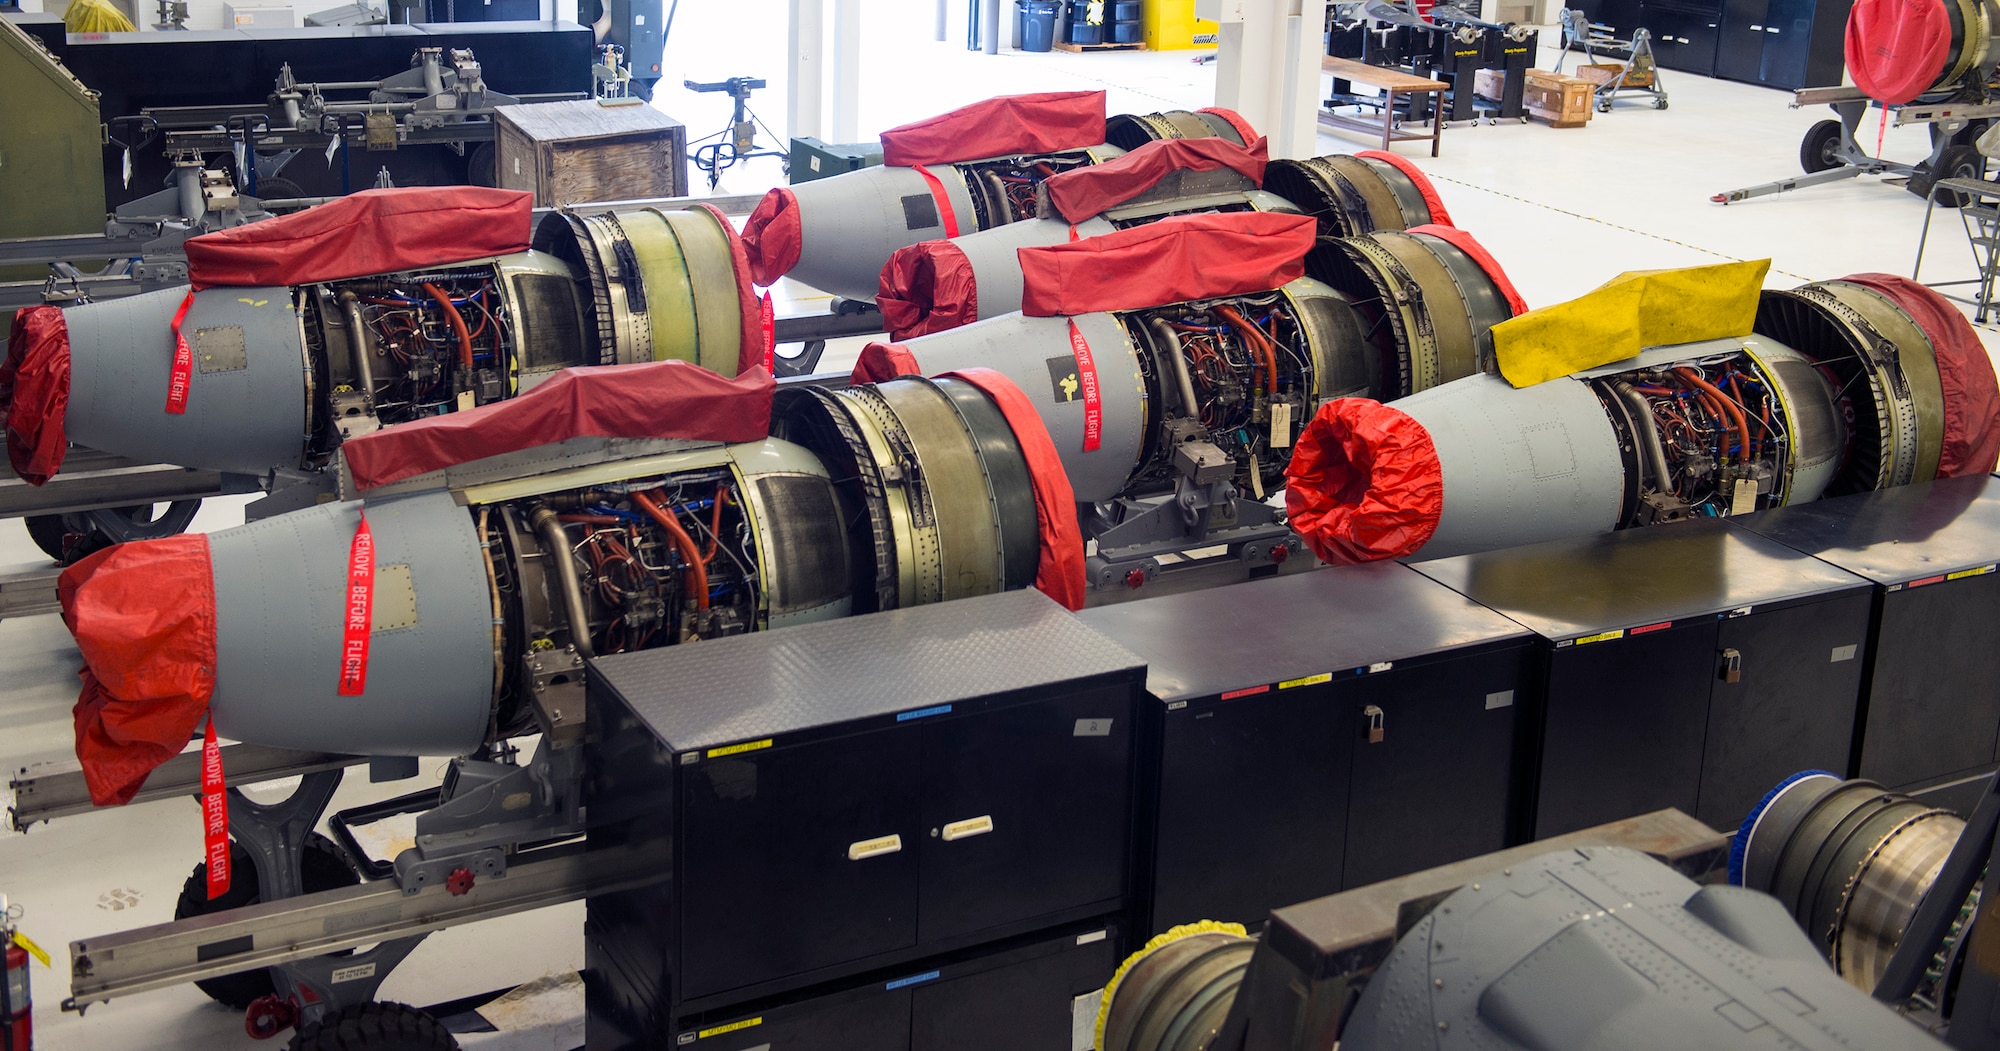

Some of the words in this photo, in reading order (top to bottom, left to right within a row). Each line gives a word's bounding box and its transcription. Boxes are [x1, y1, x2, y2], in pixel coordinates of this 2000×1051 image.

[762, 300, 771, 326] REMOVE
[1072, 334, 1090, 366] REMOVE
[170, 371, 186, 402] FLIGHT
[1083, 371, 1097, 404] BEFORE
[1088, 410, 1098, 440] FLIGHT
[354, 534, 370, 576] REMOVE
[350, 586, 367, 630] BEFORE
[345, 640, 363, 681] FLIGHT
[206, 742, 222, 786] REMOVE
[208, 793, 224, 836] BEFORE
[211, 842, 226, 882] FLIGHT
